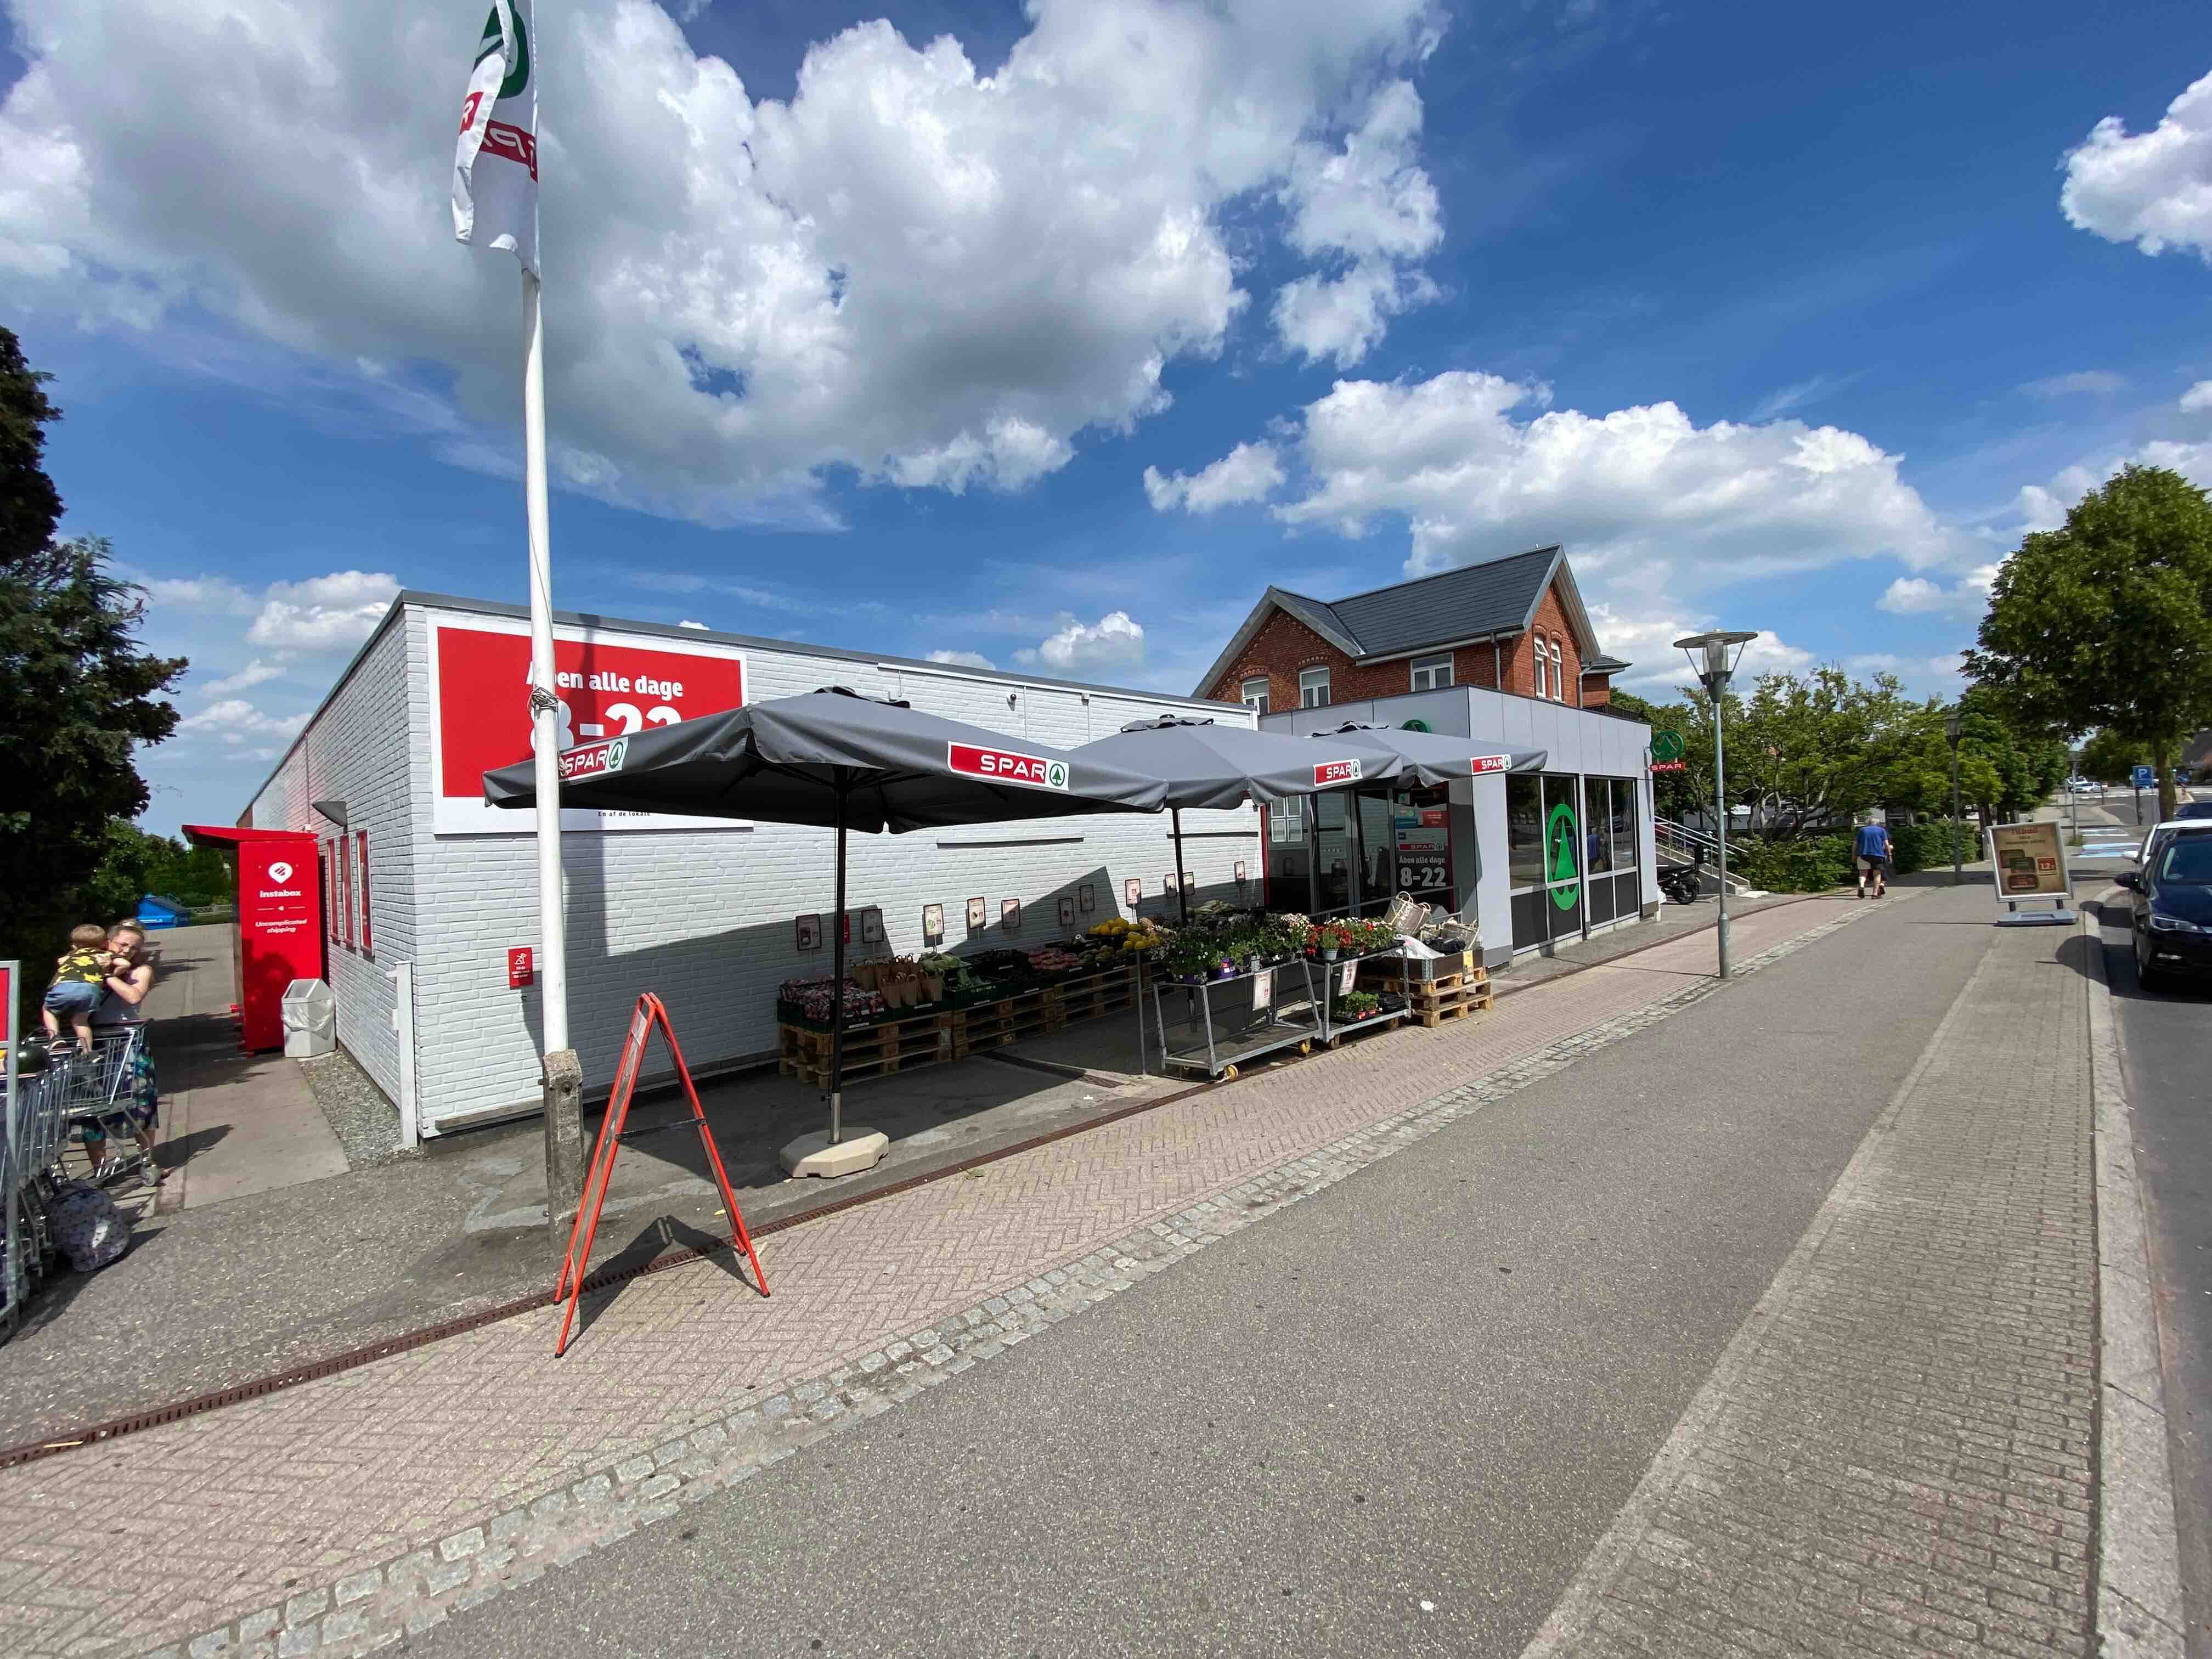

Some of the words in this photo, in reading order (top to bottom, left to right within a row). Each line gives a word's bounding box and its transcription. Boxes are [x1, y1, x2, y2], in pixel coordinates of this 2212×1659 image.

[589, 672, 630, 693] alle
[635, 675, 683, 701] dage
[562, 749, 608, 775] SPAR
[980, 754, 1046, 780] SPAR
[1482, 758, 1503, 769] SPAR
[1326, 764, 1352, 779] SPAR
[1416, 856, 1428, 864] alle
[1429, 856, 1446, 865] dage
[1400, 867, 1446, 887] 8-22
[255, 918, 307, 927] Uncomplicated
